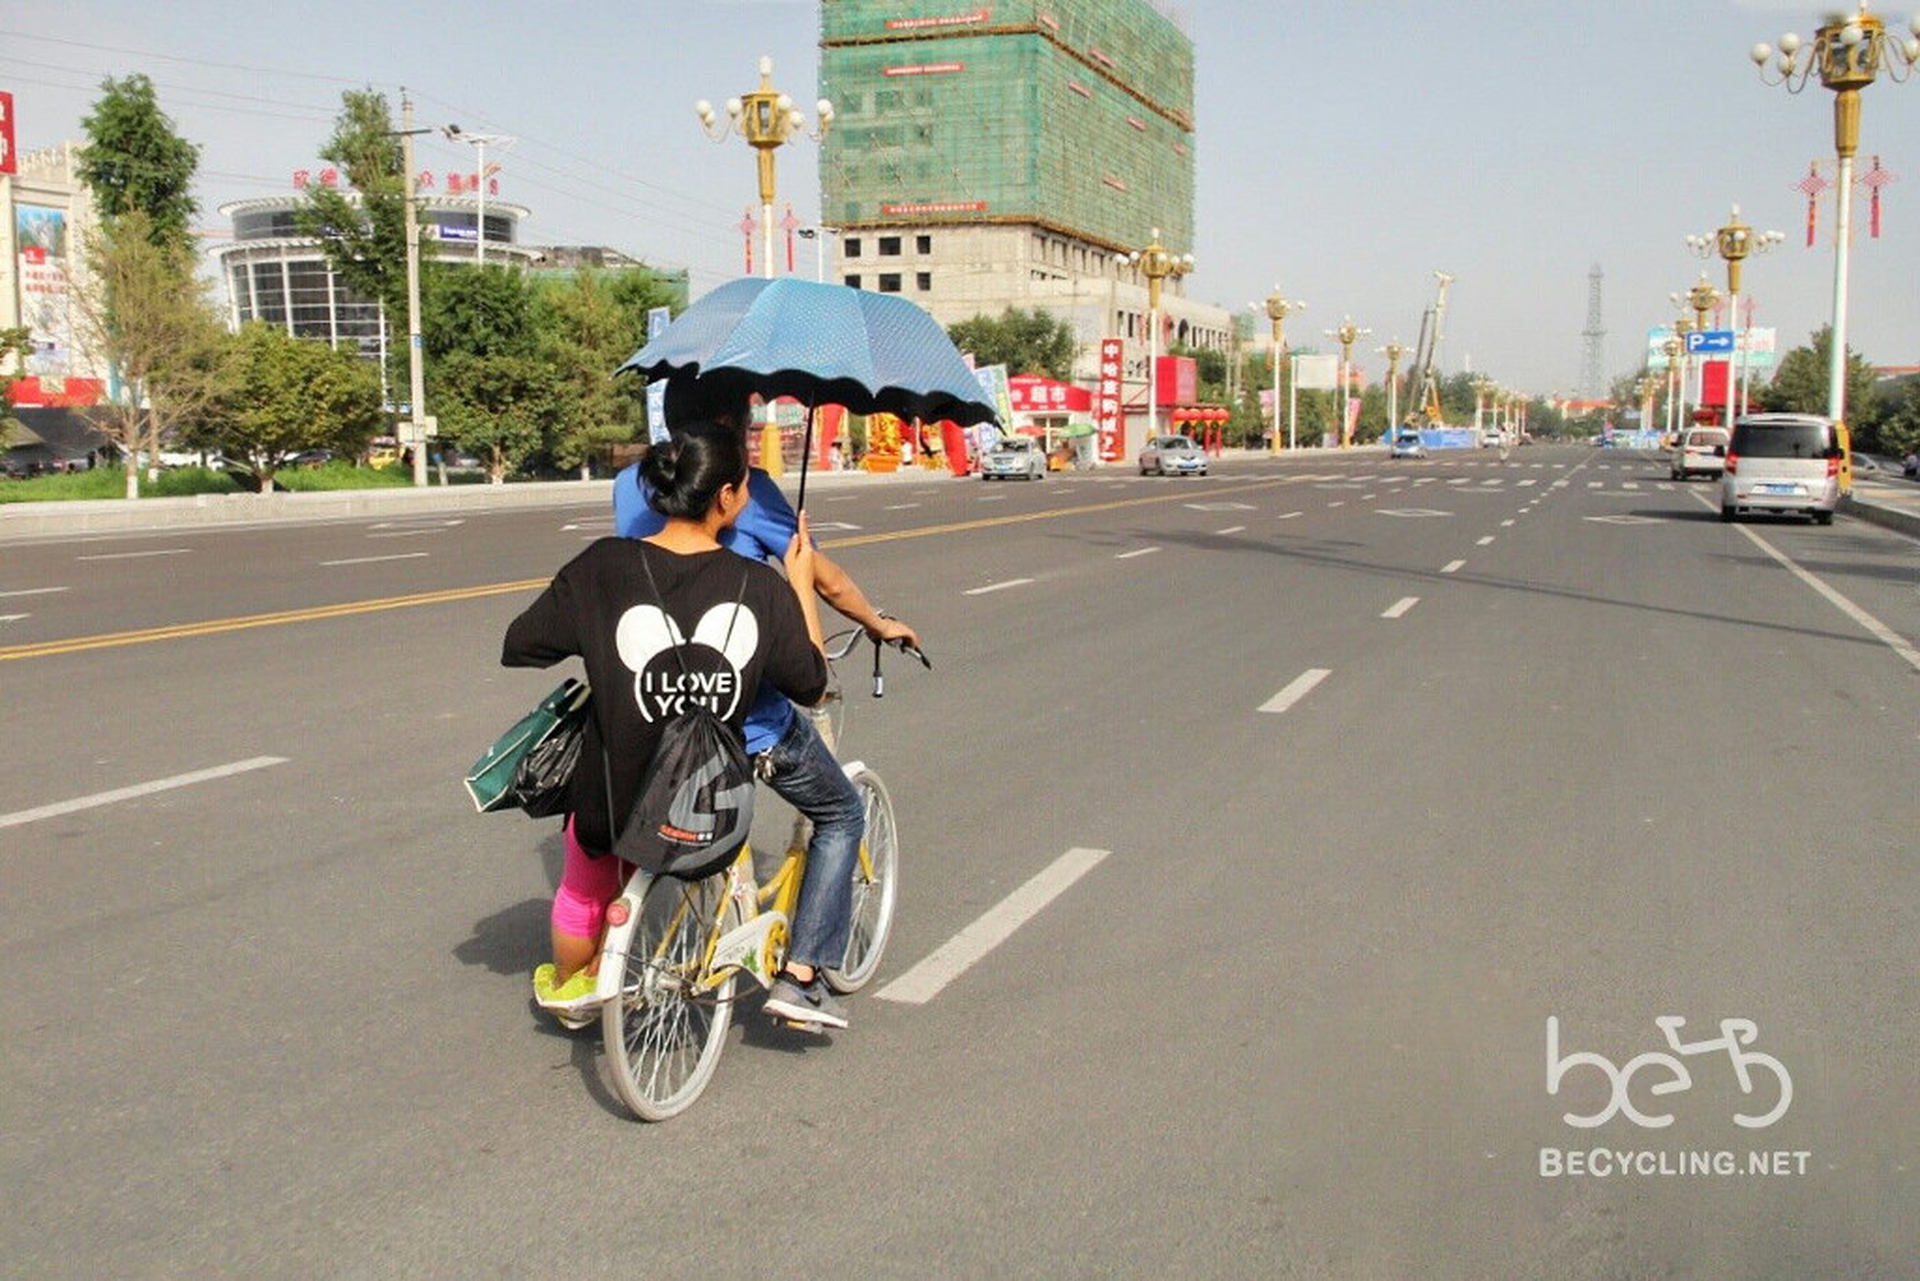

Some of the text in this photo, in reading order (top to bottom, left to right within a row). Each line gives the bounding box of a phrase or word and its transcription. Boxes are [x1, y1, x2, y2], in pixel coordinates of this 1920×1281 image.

[1689, 334, 1705, 350] P
[646, 671, 732, 693] I LOVE
[654, 694, 719, 717] YOU
